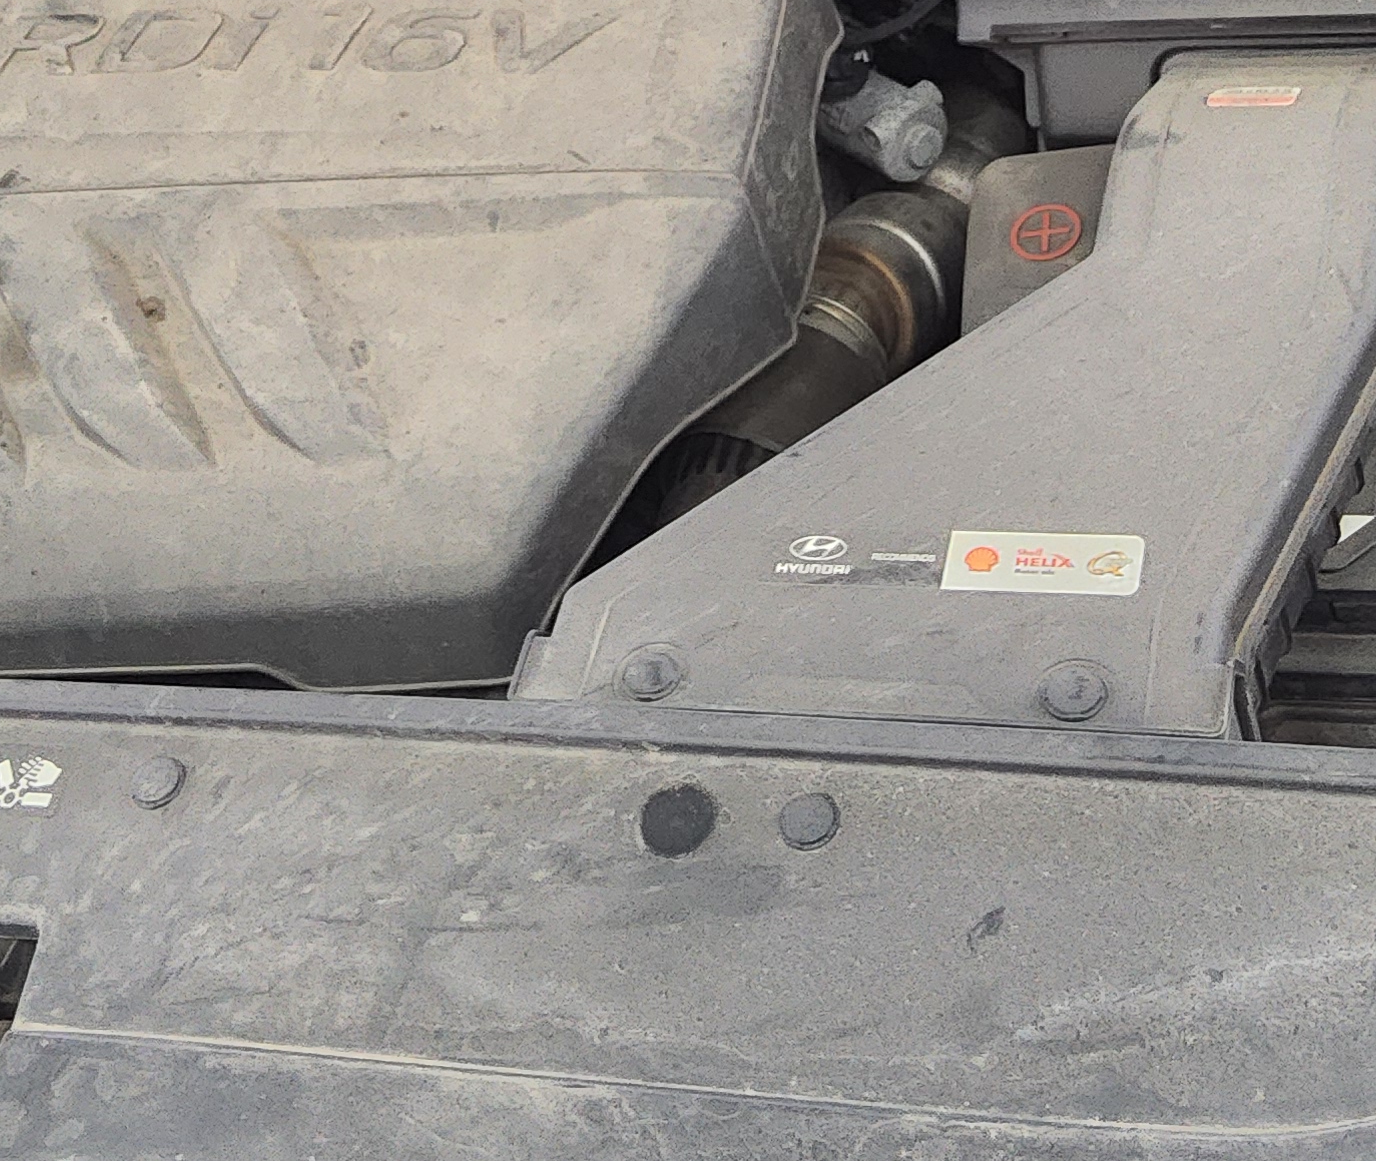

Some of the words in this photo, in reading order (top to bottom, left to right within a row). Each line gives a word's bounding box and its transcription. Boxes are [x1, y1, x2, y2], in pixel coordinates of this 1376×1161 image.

[304, 0, 623, 75] 16V
[1015, 555, 1074, 568] HELIX
[774, 562, 852, 575] HYUNDAI
